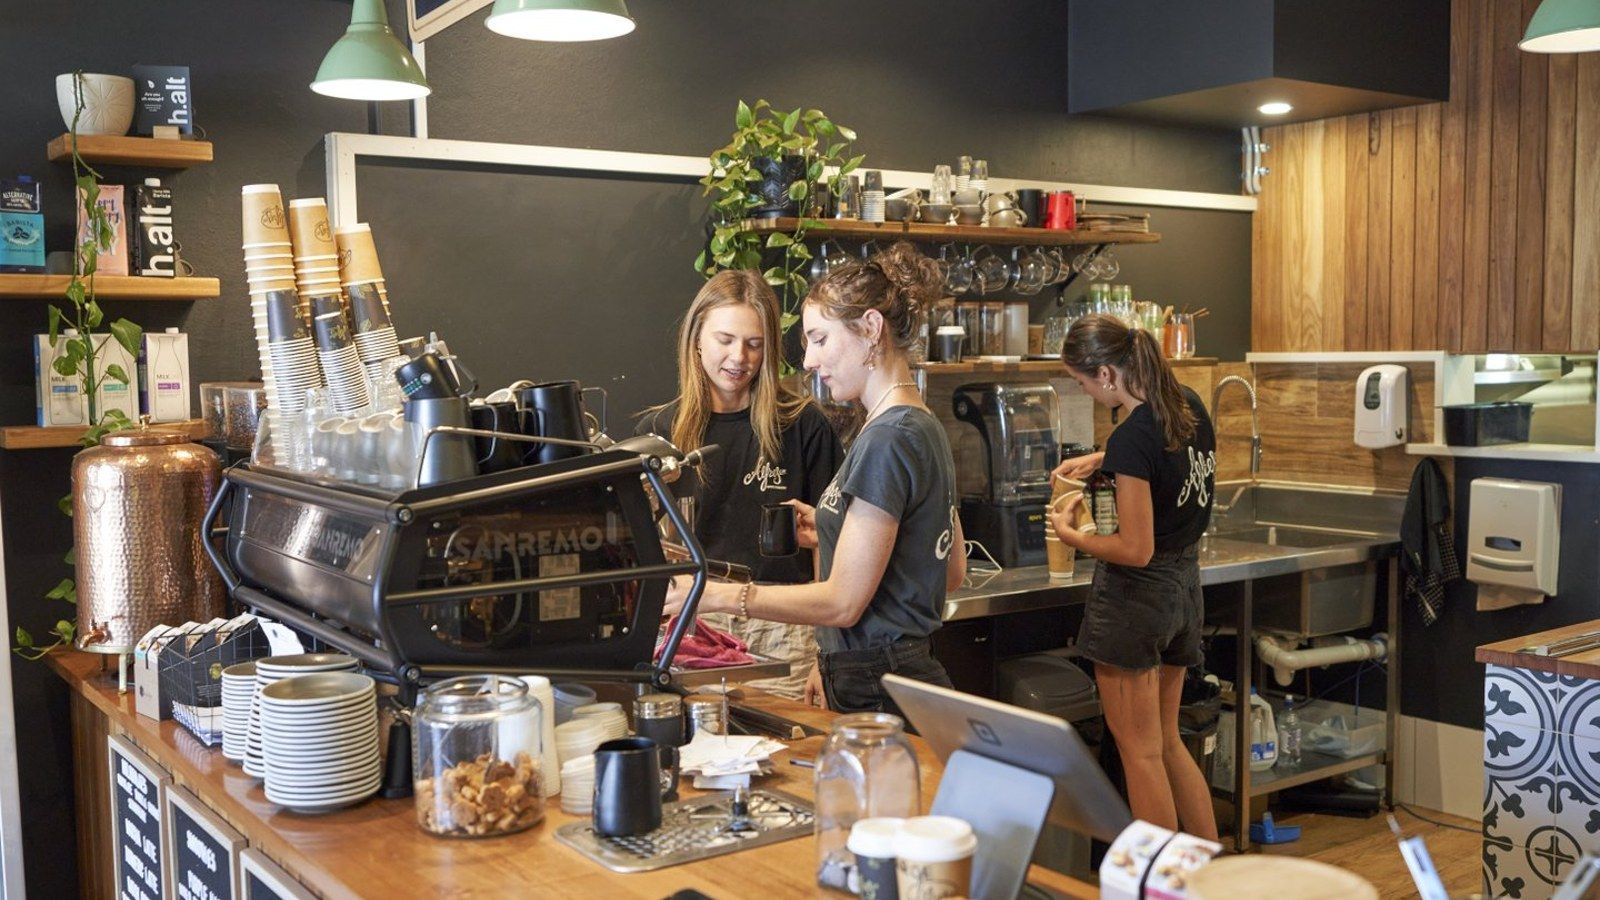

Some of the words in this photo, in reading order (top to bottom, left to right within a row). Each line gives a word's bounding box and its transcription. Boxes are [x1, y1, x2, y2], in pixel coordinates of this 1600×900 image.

[165, 77, 188, 124] h.alt
[140, 204, 174, 277] h.alt
[454, 525, 603, 562] SANREMO
